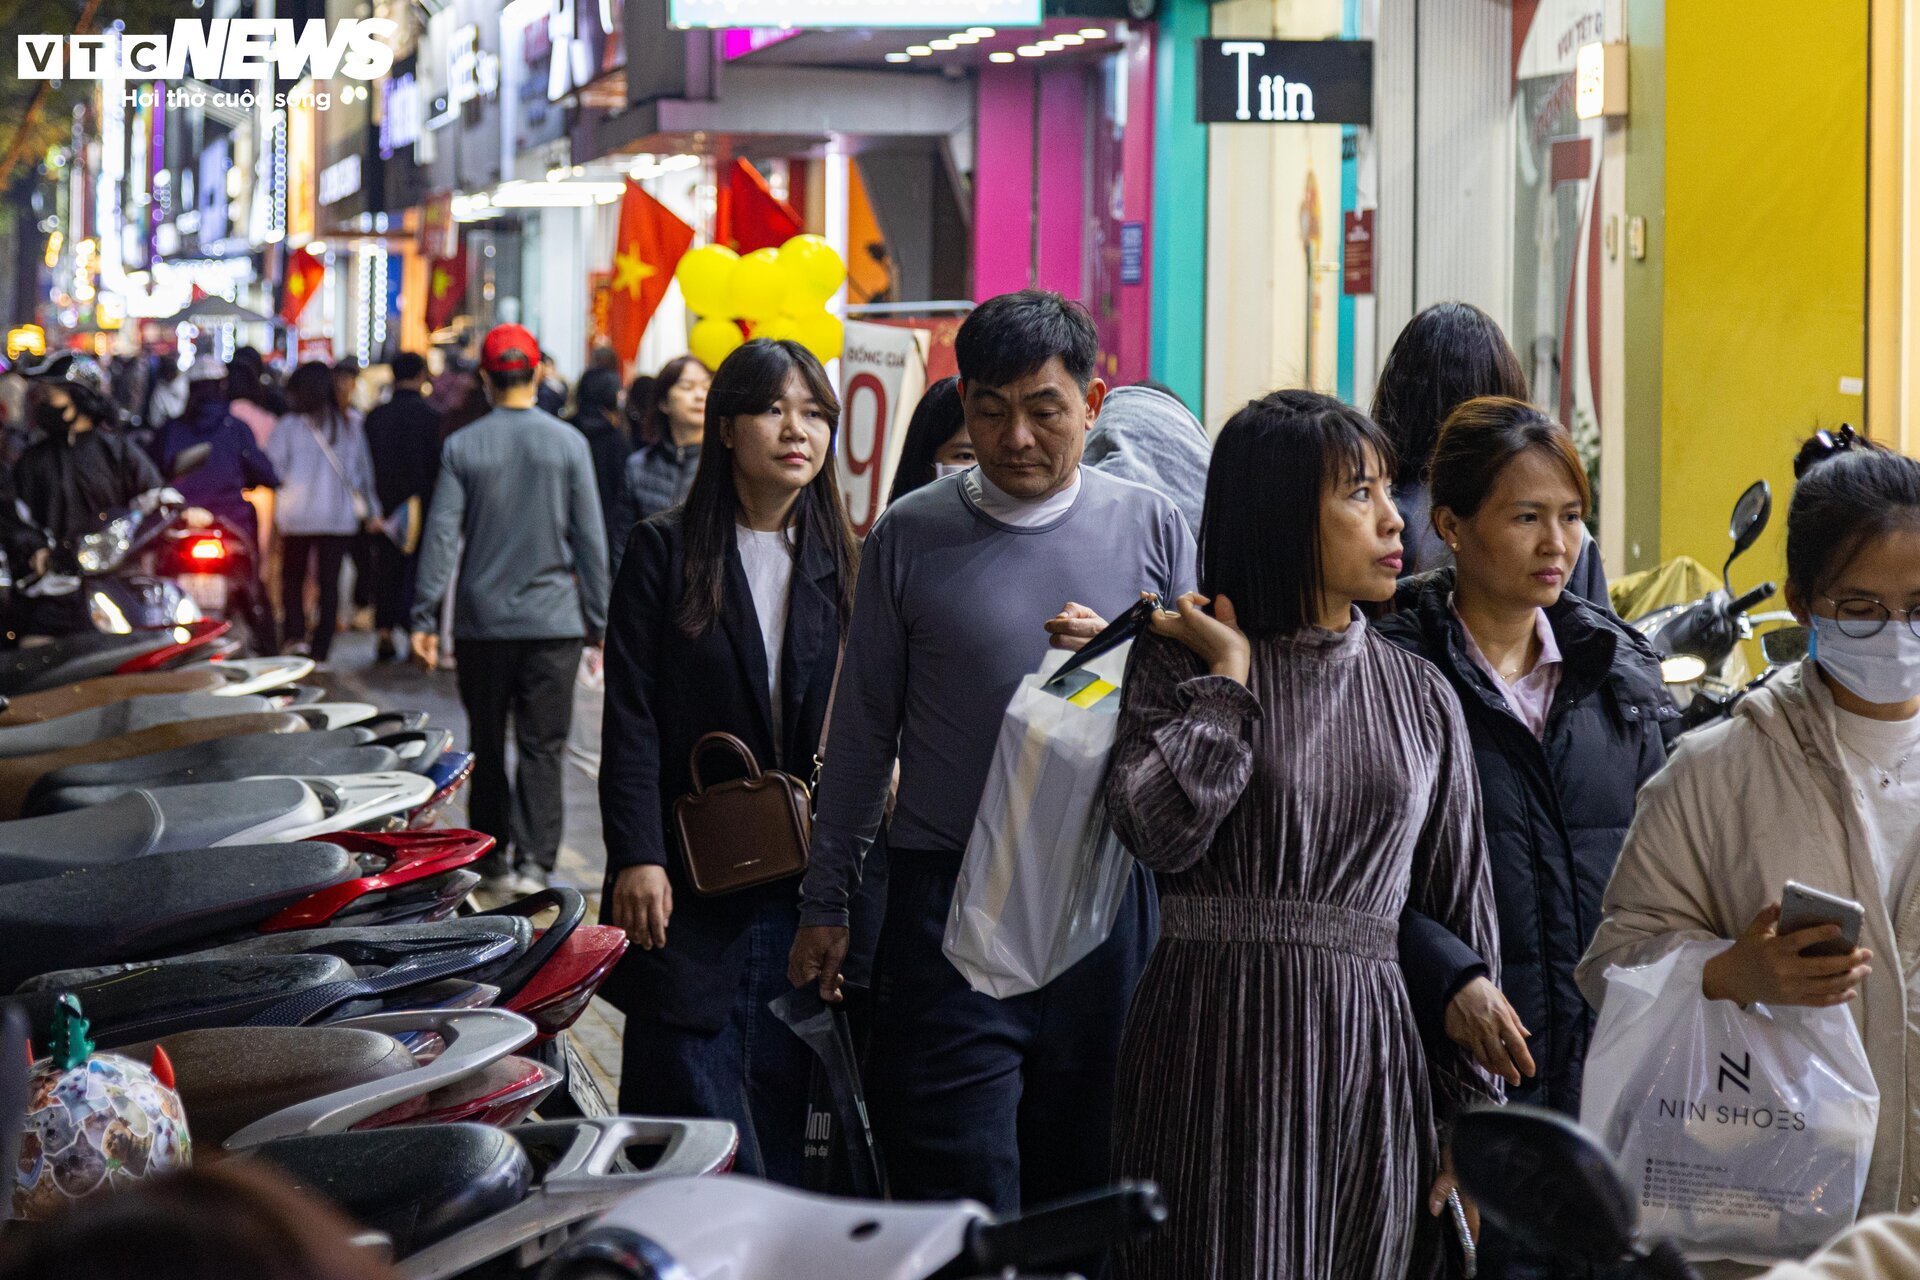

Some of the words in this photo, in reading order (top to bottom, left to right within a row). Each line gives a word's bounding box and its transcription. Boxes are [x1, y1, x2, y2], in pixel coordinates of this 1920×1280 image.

[1221, 42, 1315, 120] Tiin
[1659, 1098, 1706, 1122] NIN
[1716, 1105, 1806, 1131] SHOES
